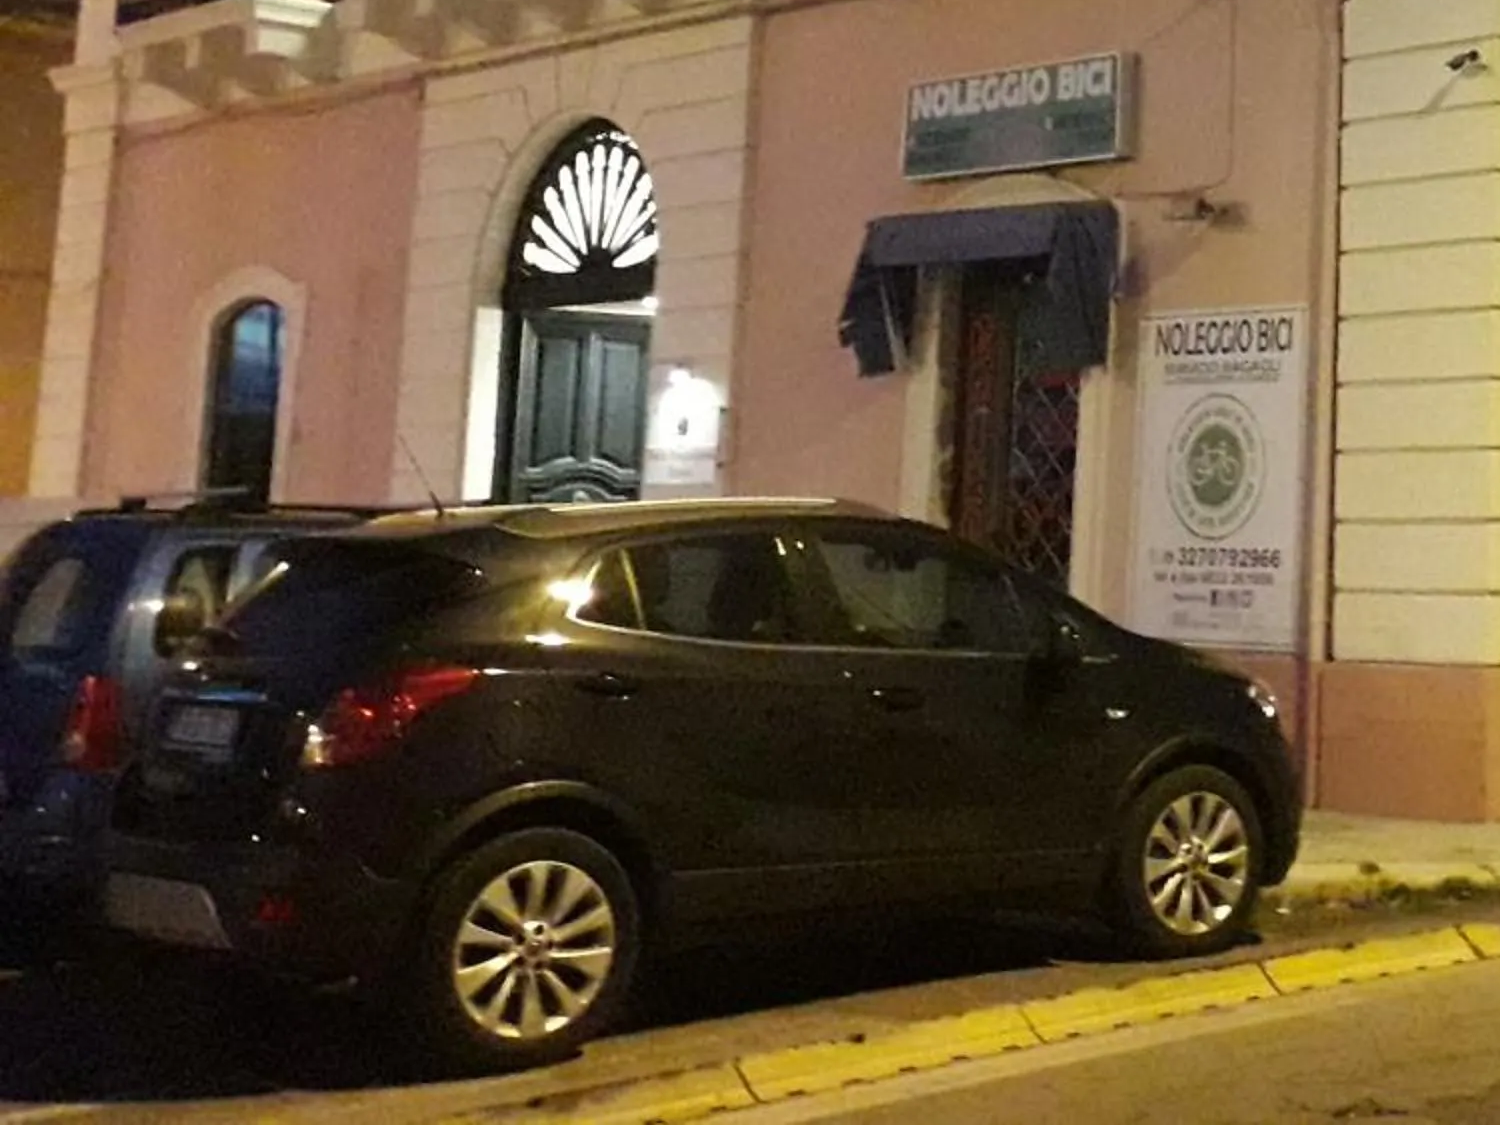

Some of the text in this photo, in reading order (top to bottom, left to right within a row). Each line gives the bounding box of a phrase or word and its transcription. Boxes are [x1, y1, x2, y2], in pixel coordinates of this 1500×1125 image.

[911, 58, 1113, 121] NOLEGGIO BICI
[1155, 317, 1294, 357] NOLEGGIO BICI
